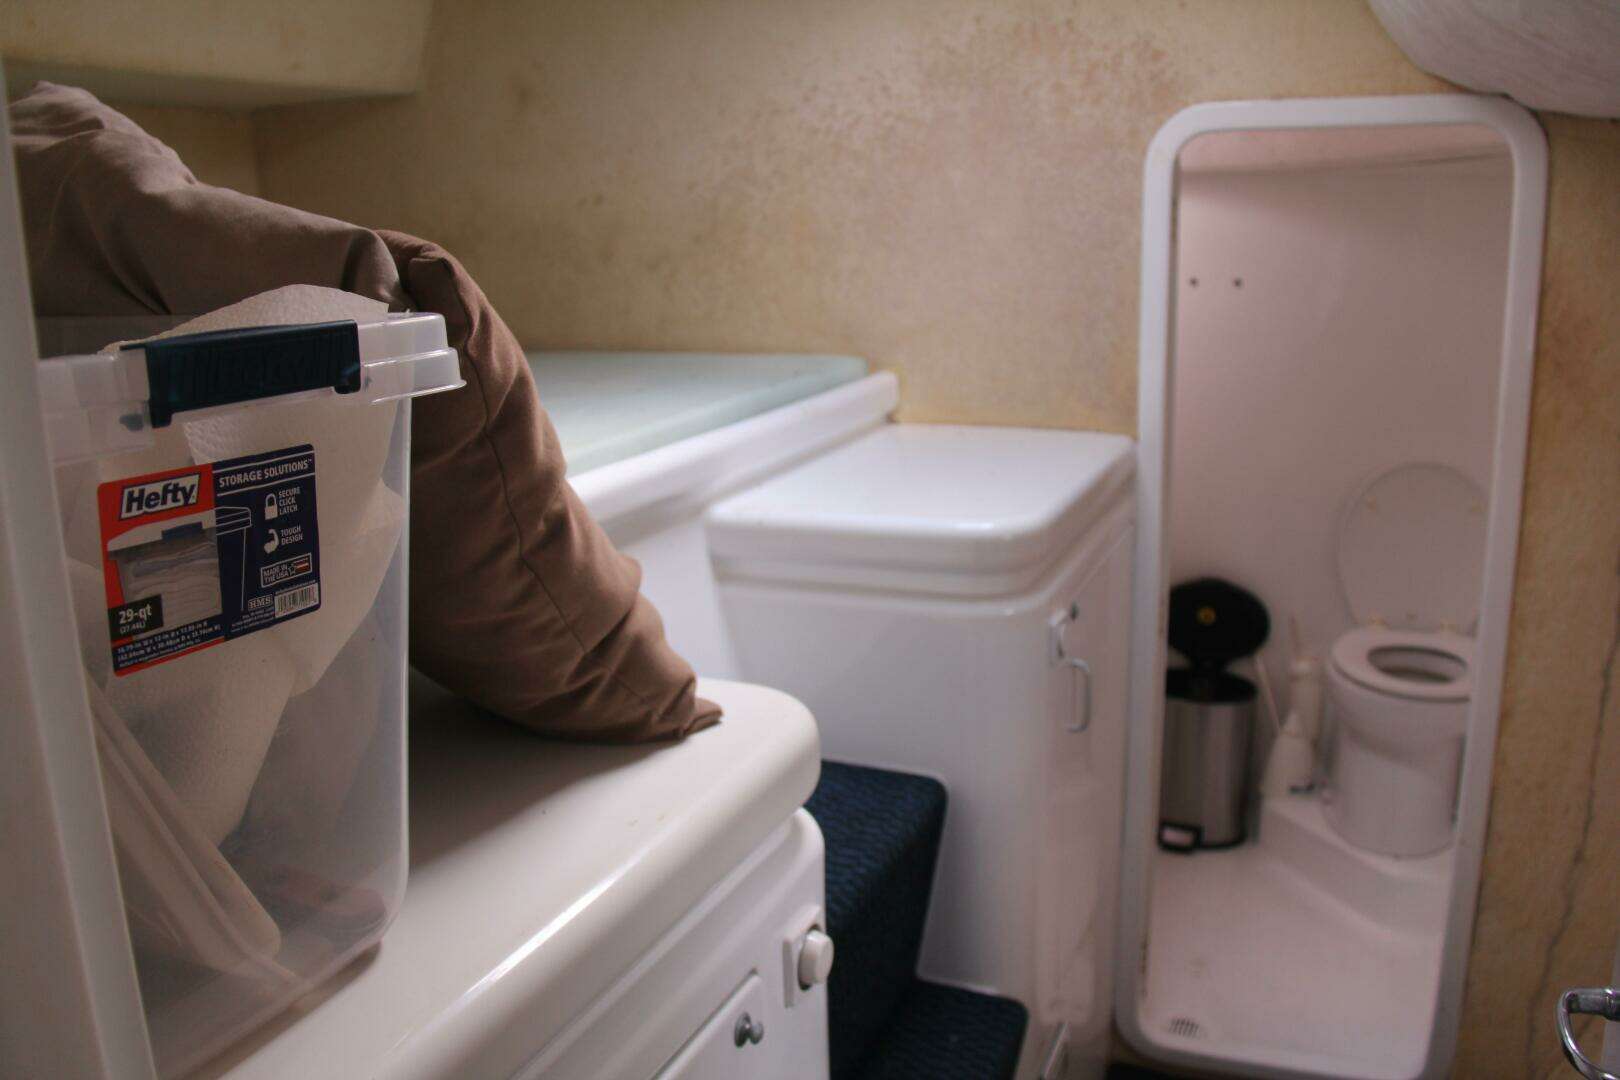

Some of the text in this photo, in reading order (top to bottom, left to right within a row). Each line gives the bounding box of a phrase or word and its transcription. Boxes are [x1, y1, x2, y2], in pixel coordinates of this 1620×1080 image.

[219, 470, 262, 488] STORAGE
[125, 480, 196, 514] Hefty
[278, 486, 301, 498] SECURE
[279, 496, 296, 507] CLICK
[279, 504, 299, 516] LATCH
[280, 525, 301, 537] TOUGH
[281, 534, 303, 546] DESIGN
[263, 563, 288, 577] MADE IN
[264, 570, 289, 584] THE USA
[119, 603, 153, 624] 29-qt
